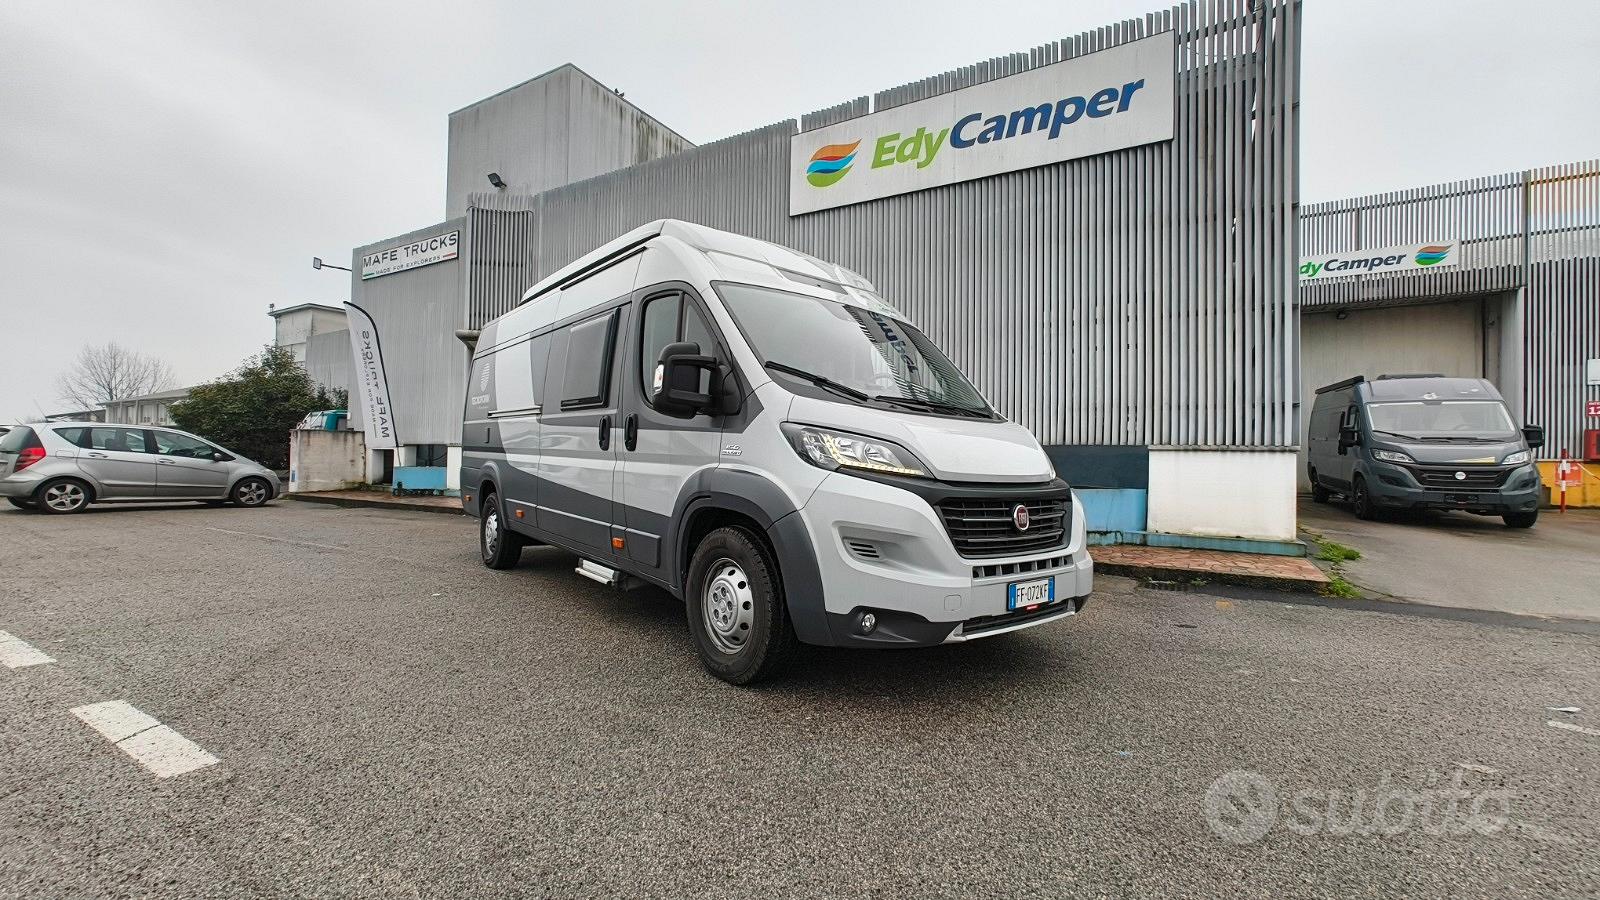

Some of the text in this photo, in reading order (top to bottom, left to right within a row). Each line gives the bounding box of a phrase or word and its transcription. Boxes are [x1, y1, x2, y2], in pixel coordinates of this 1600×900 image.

[871, 78, 1145, 170] EdyCamper
[363, 233, 457, 268] MAFE TRUCKS
[1300, 253, 1407, 277] dyCamper
